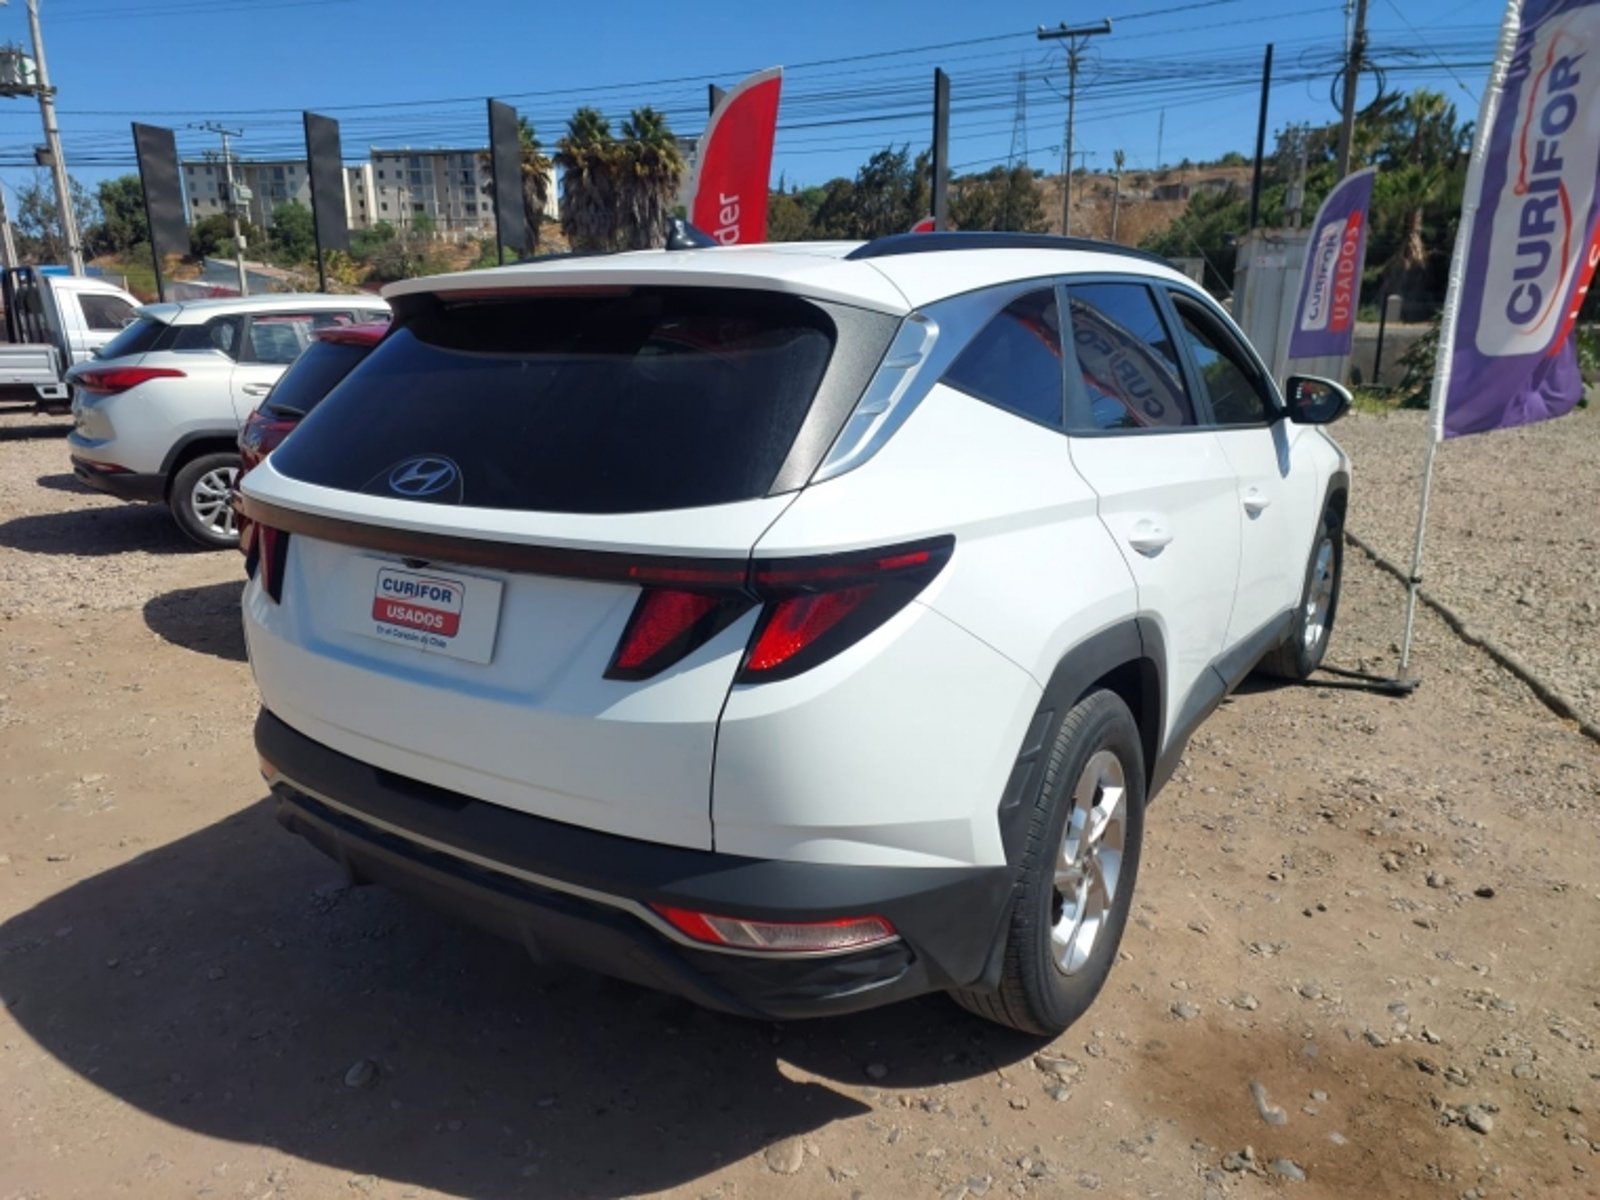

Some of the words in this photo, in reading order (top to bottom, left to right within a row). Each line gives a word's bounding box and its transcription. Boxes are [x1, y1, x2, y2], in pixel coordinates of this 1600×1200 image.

[1506, 51, 1587, 326] CURIFOR
[1309, 233, 1338, 321] CURIFOR
[1334, 226, 1360, 321] USADOS
[382, 578, 453, 603] CURIFOR
[386, 605, 444, 628] USADOS
